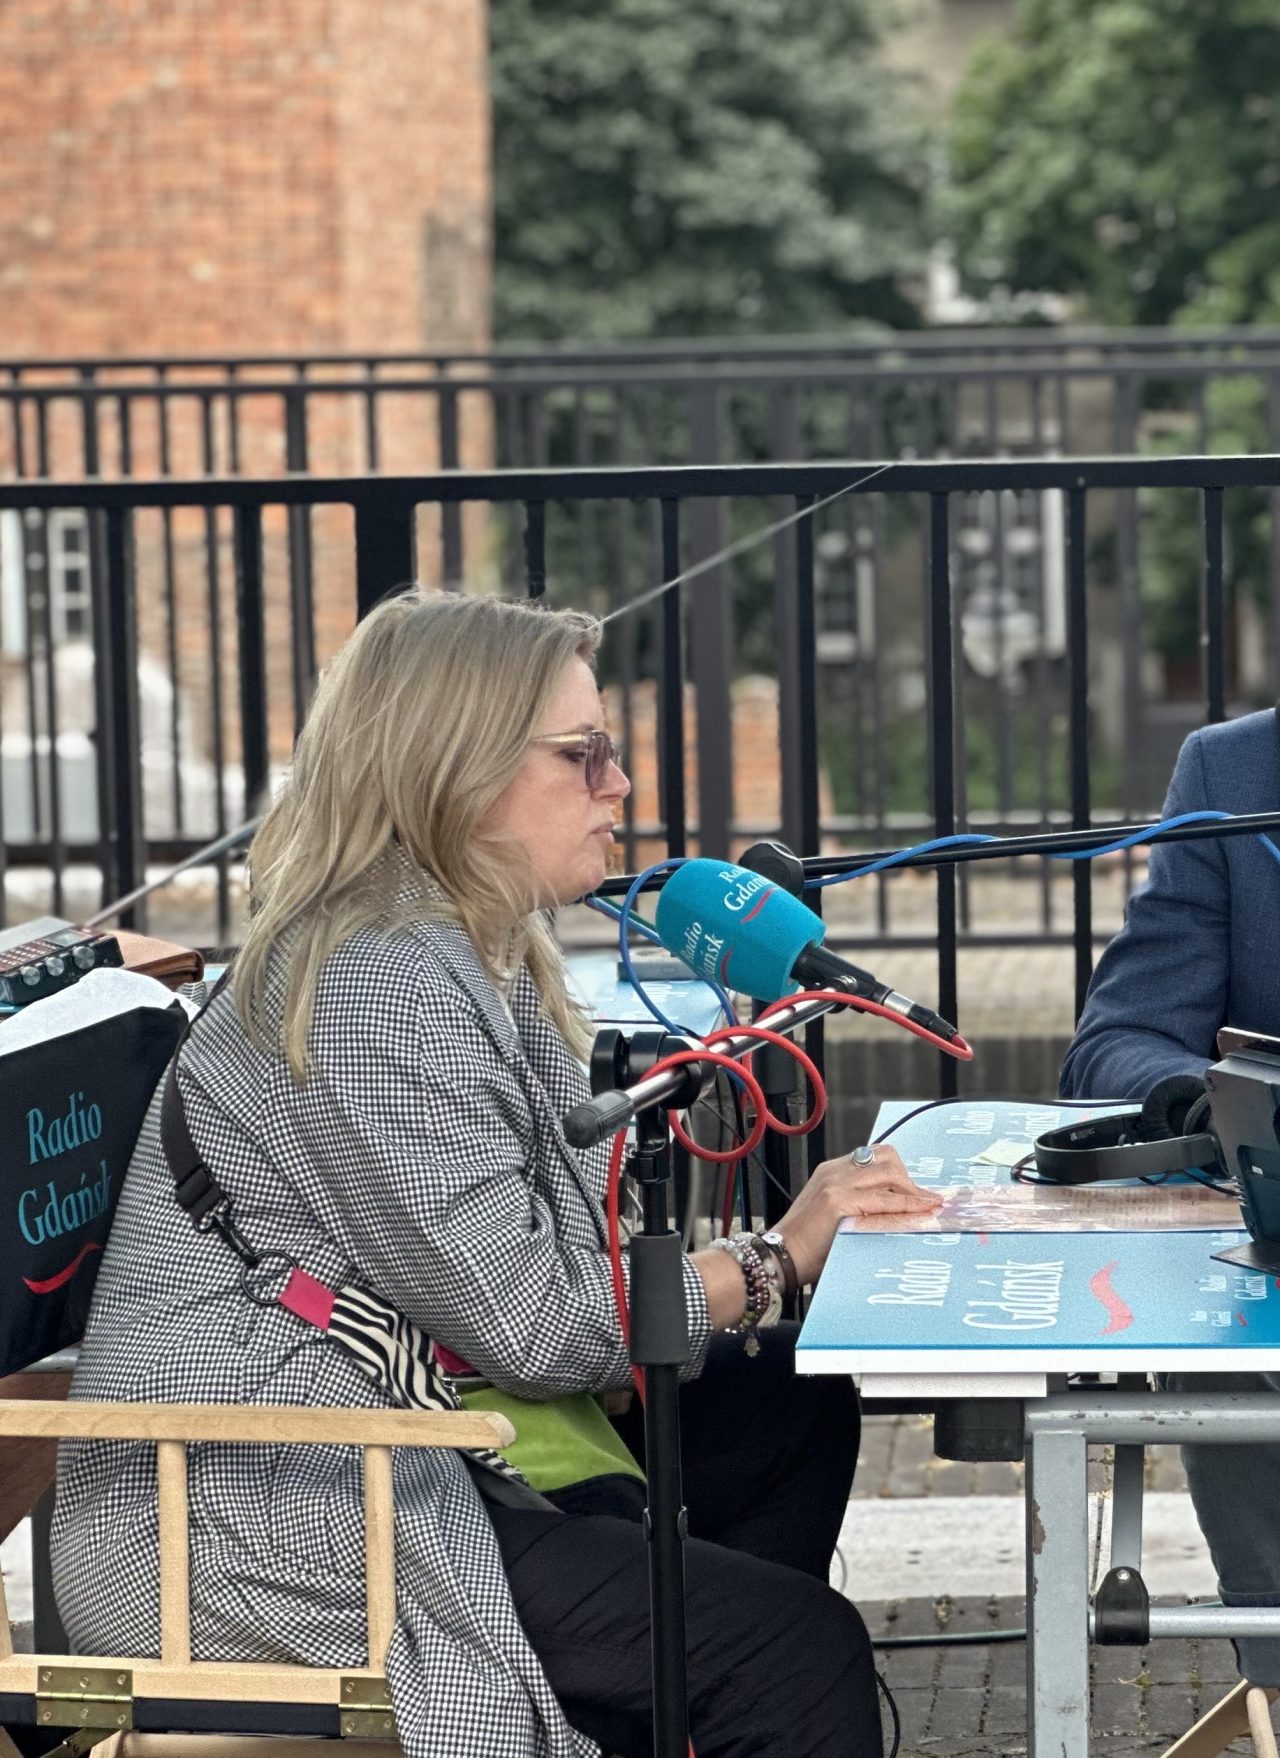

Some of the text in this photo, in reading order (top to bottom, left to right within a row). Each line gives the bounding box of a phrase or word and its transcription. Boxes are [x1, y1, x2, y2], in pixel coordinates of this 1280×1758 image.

[723, 872, 777, 912] Gdań
[26, 1091, 103, 1166] Radio
[18, 1159, 112, 1246] Gdańsk
[866, 1259, 954, 1308] Radio
[961, 1258, 1065, 1331] Gdańsk
